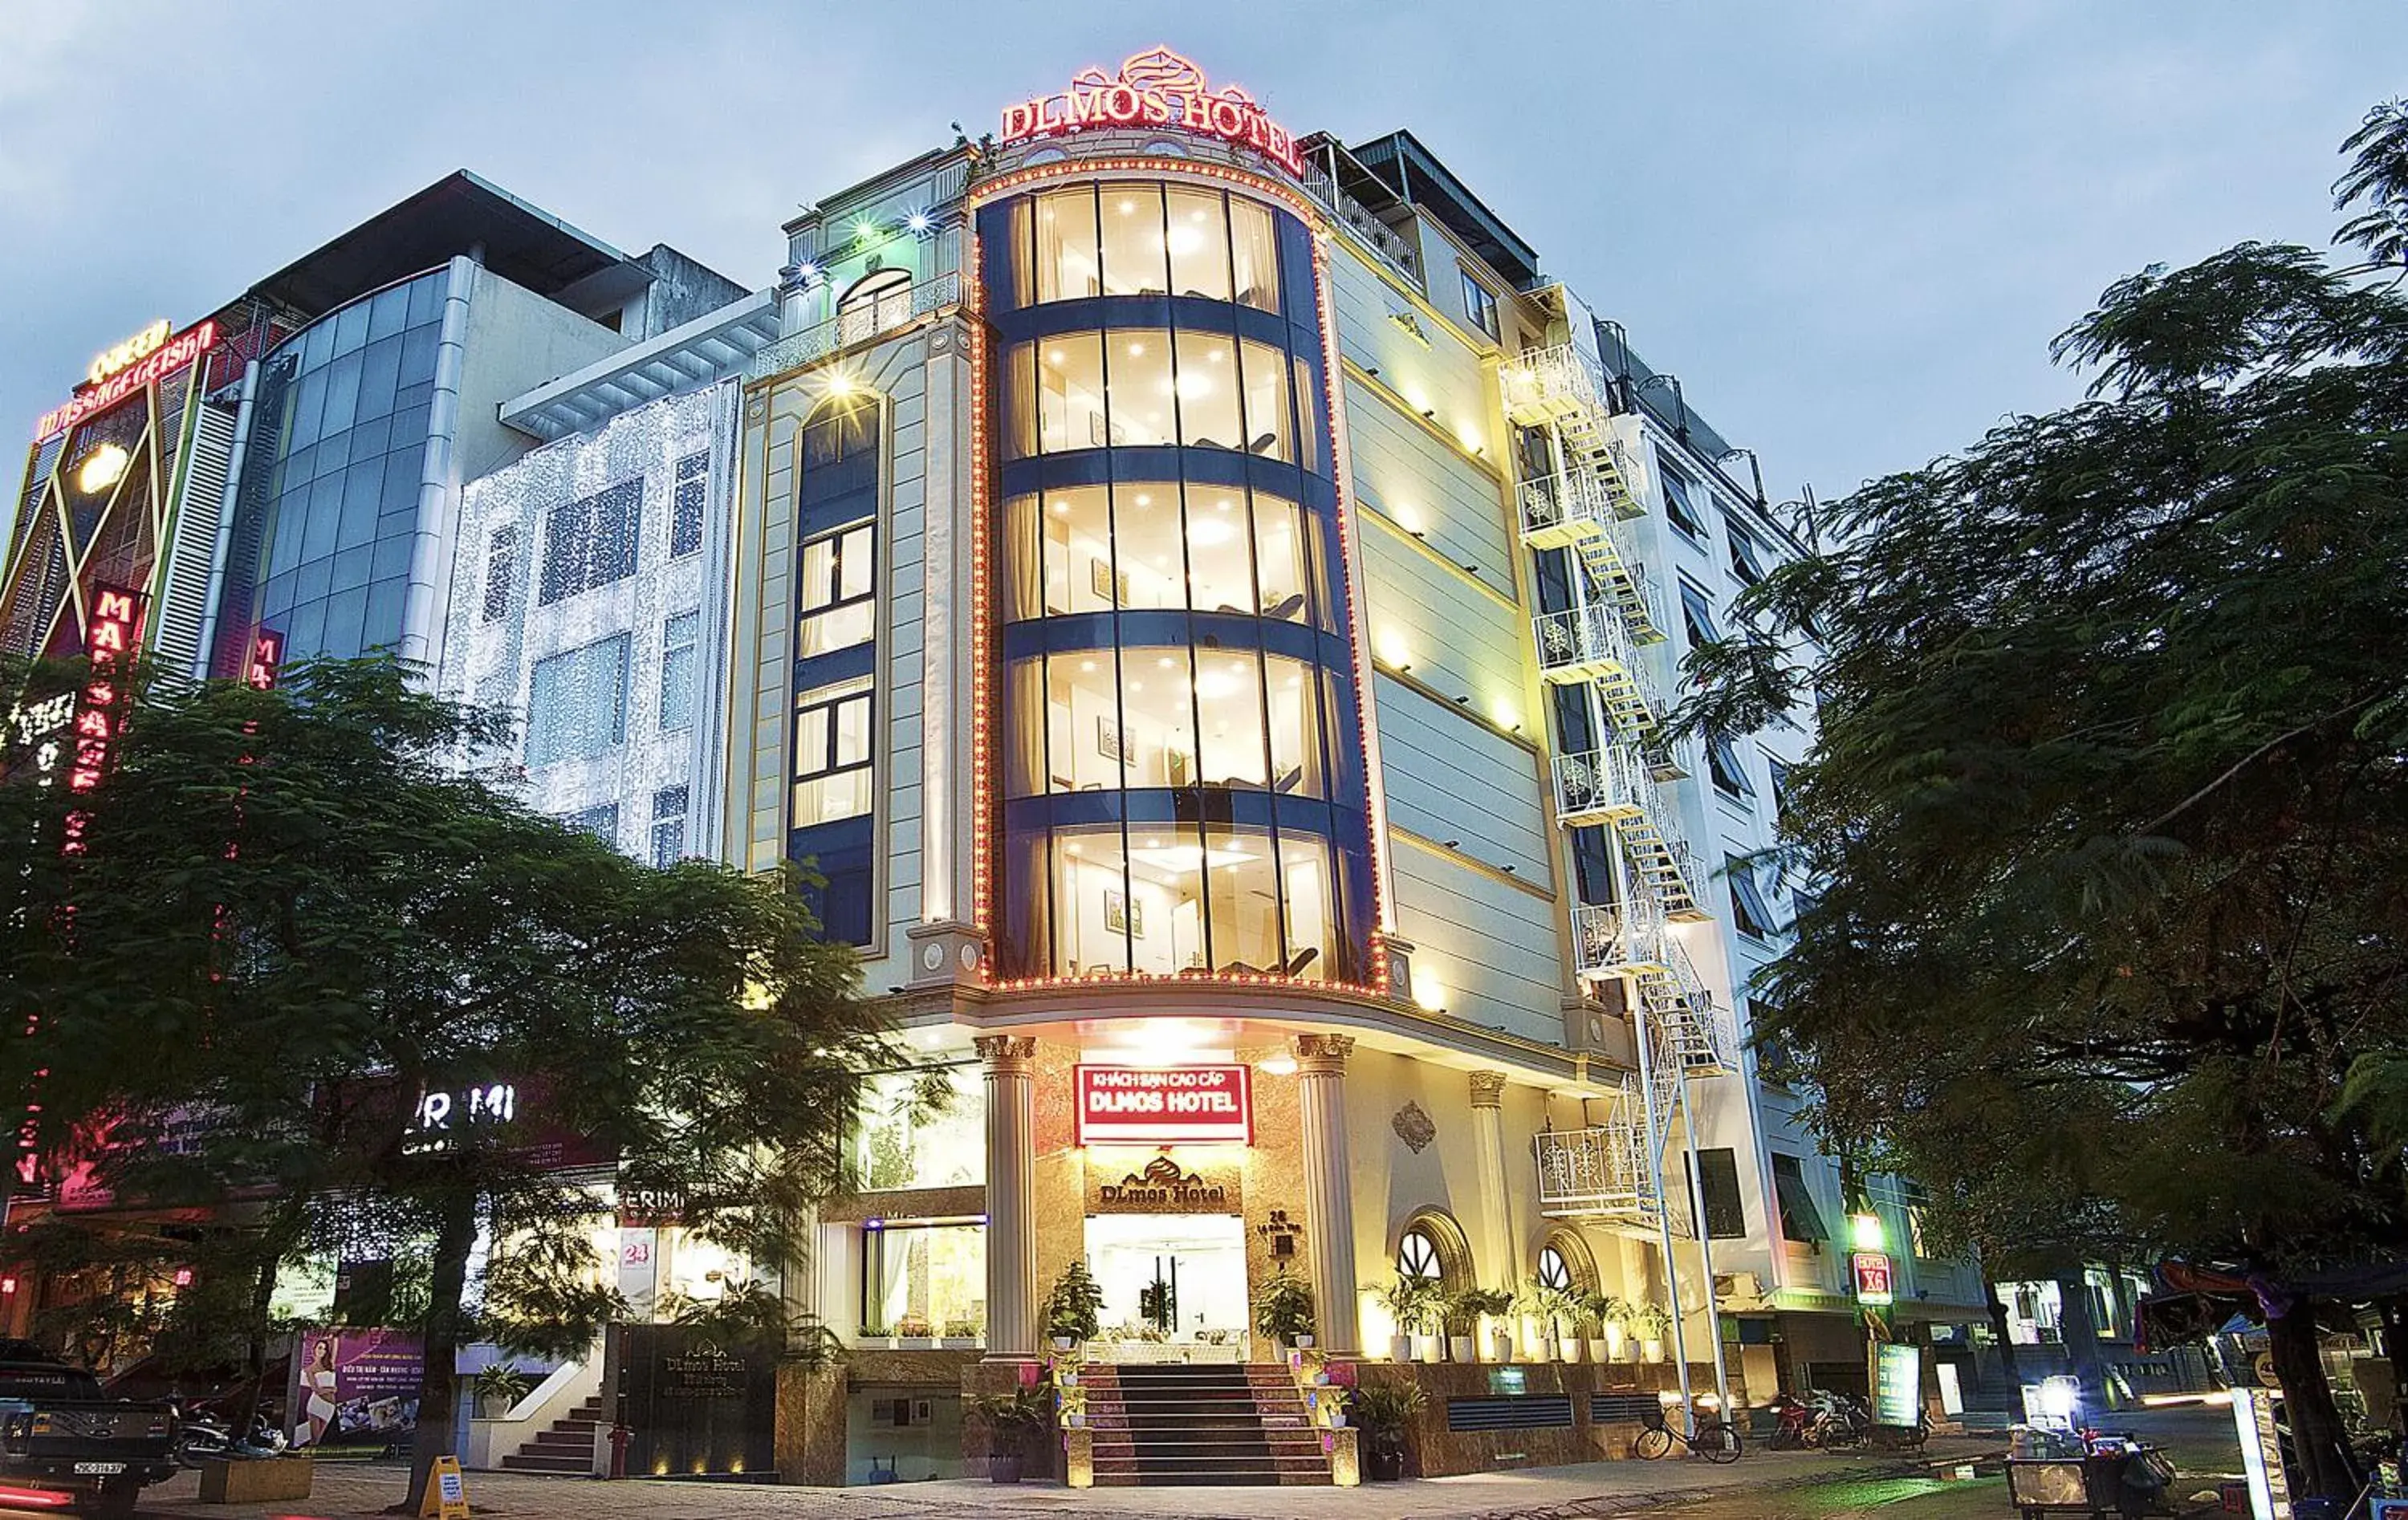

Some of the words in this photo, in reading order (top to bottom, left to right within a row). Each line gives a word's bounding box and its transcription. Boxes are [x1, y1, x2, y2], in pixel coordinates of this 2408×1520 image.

[1183, 91, 1305, 178] HOTEL
[89, 319, 169, 384] QUEEN
[1092, 1071, 1138, 1087] KHÁCH
[1169, 1073, 1197, 1087] CAO
[1089, 1091, 1163, 1113] DLMOS
[1167, 1091, 1238, 1112] HOTEL
[1173, 1185, 1224, 1202] Hotel
